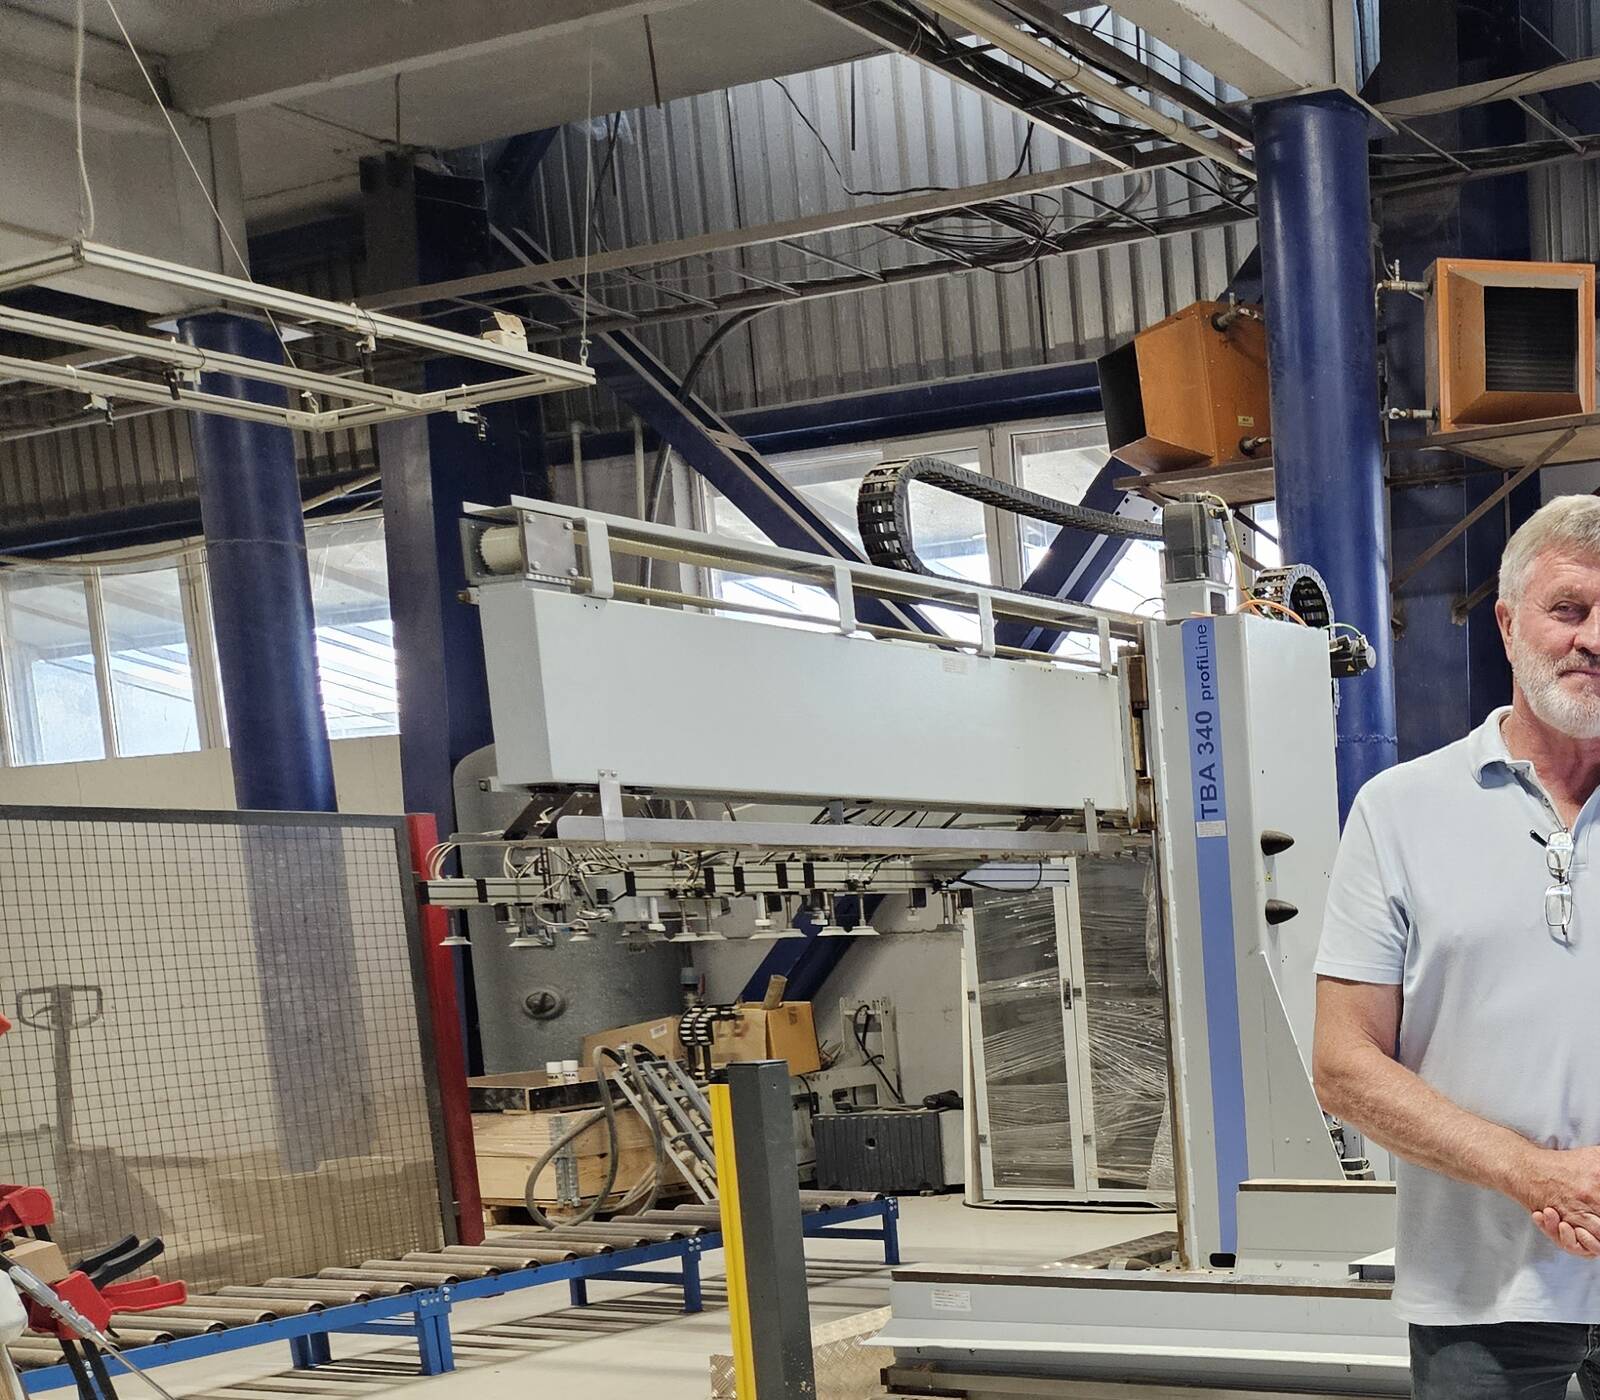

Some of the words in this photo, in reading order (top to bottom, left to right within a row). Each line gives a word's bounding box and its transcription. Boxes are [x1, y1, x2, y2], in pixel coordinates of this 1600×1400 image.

[1196, 624, 1214, 700] profiLine
[1195, 711, 1214, 754] 340
[1199, 763, 1218, 819] TBA
